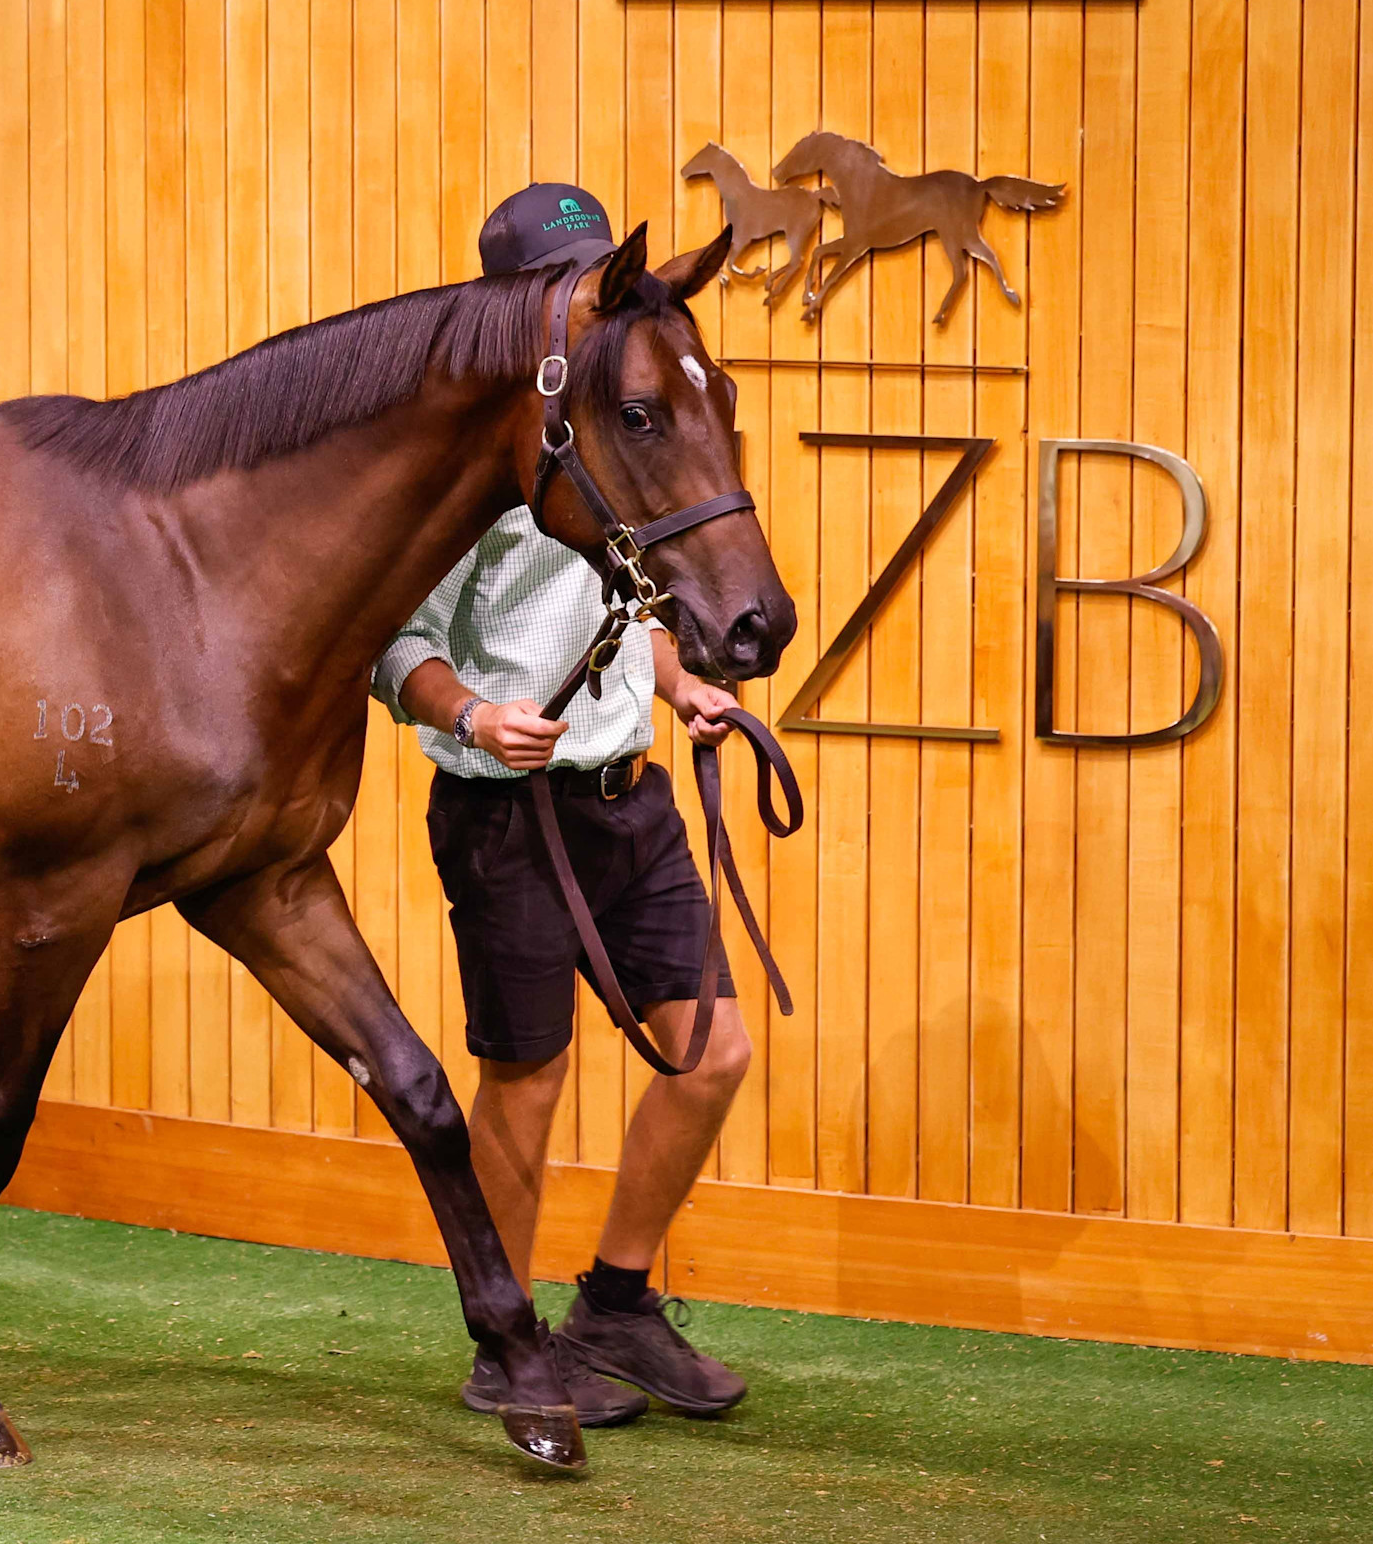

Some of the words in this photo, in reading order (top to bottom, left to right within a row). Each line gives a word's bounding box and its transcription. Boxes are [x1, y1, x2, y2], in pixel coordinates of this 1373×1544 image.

[566, 221, 590, 231] PARK
[708, 430, 1225, 747] ZB
[33, 699, 113, 747] 102
